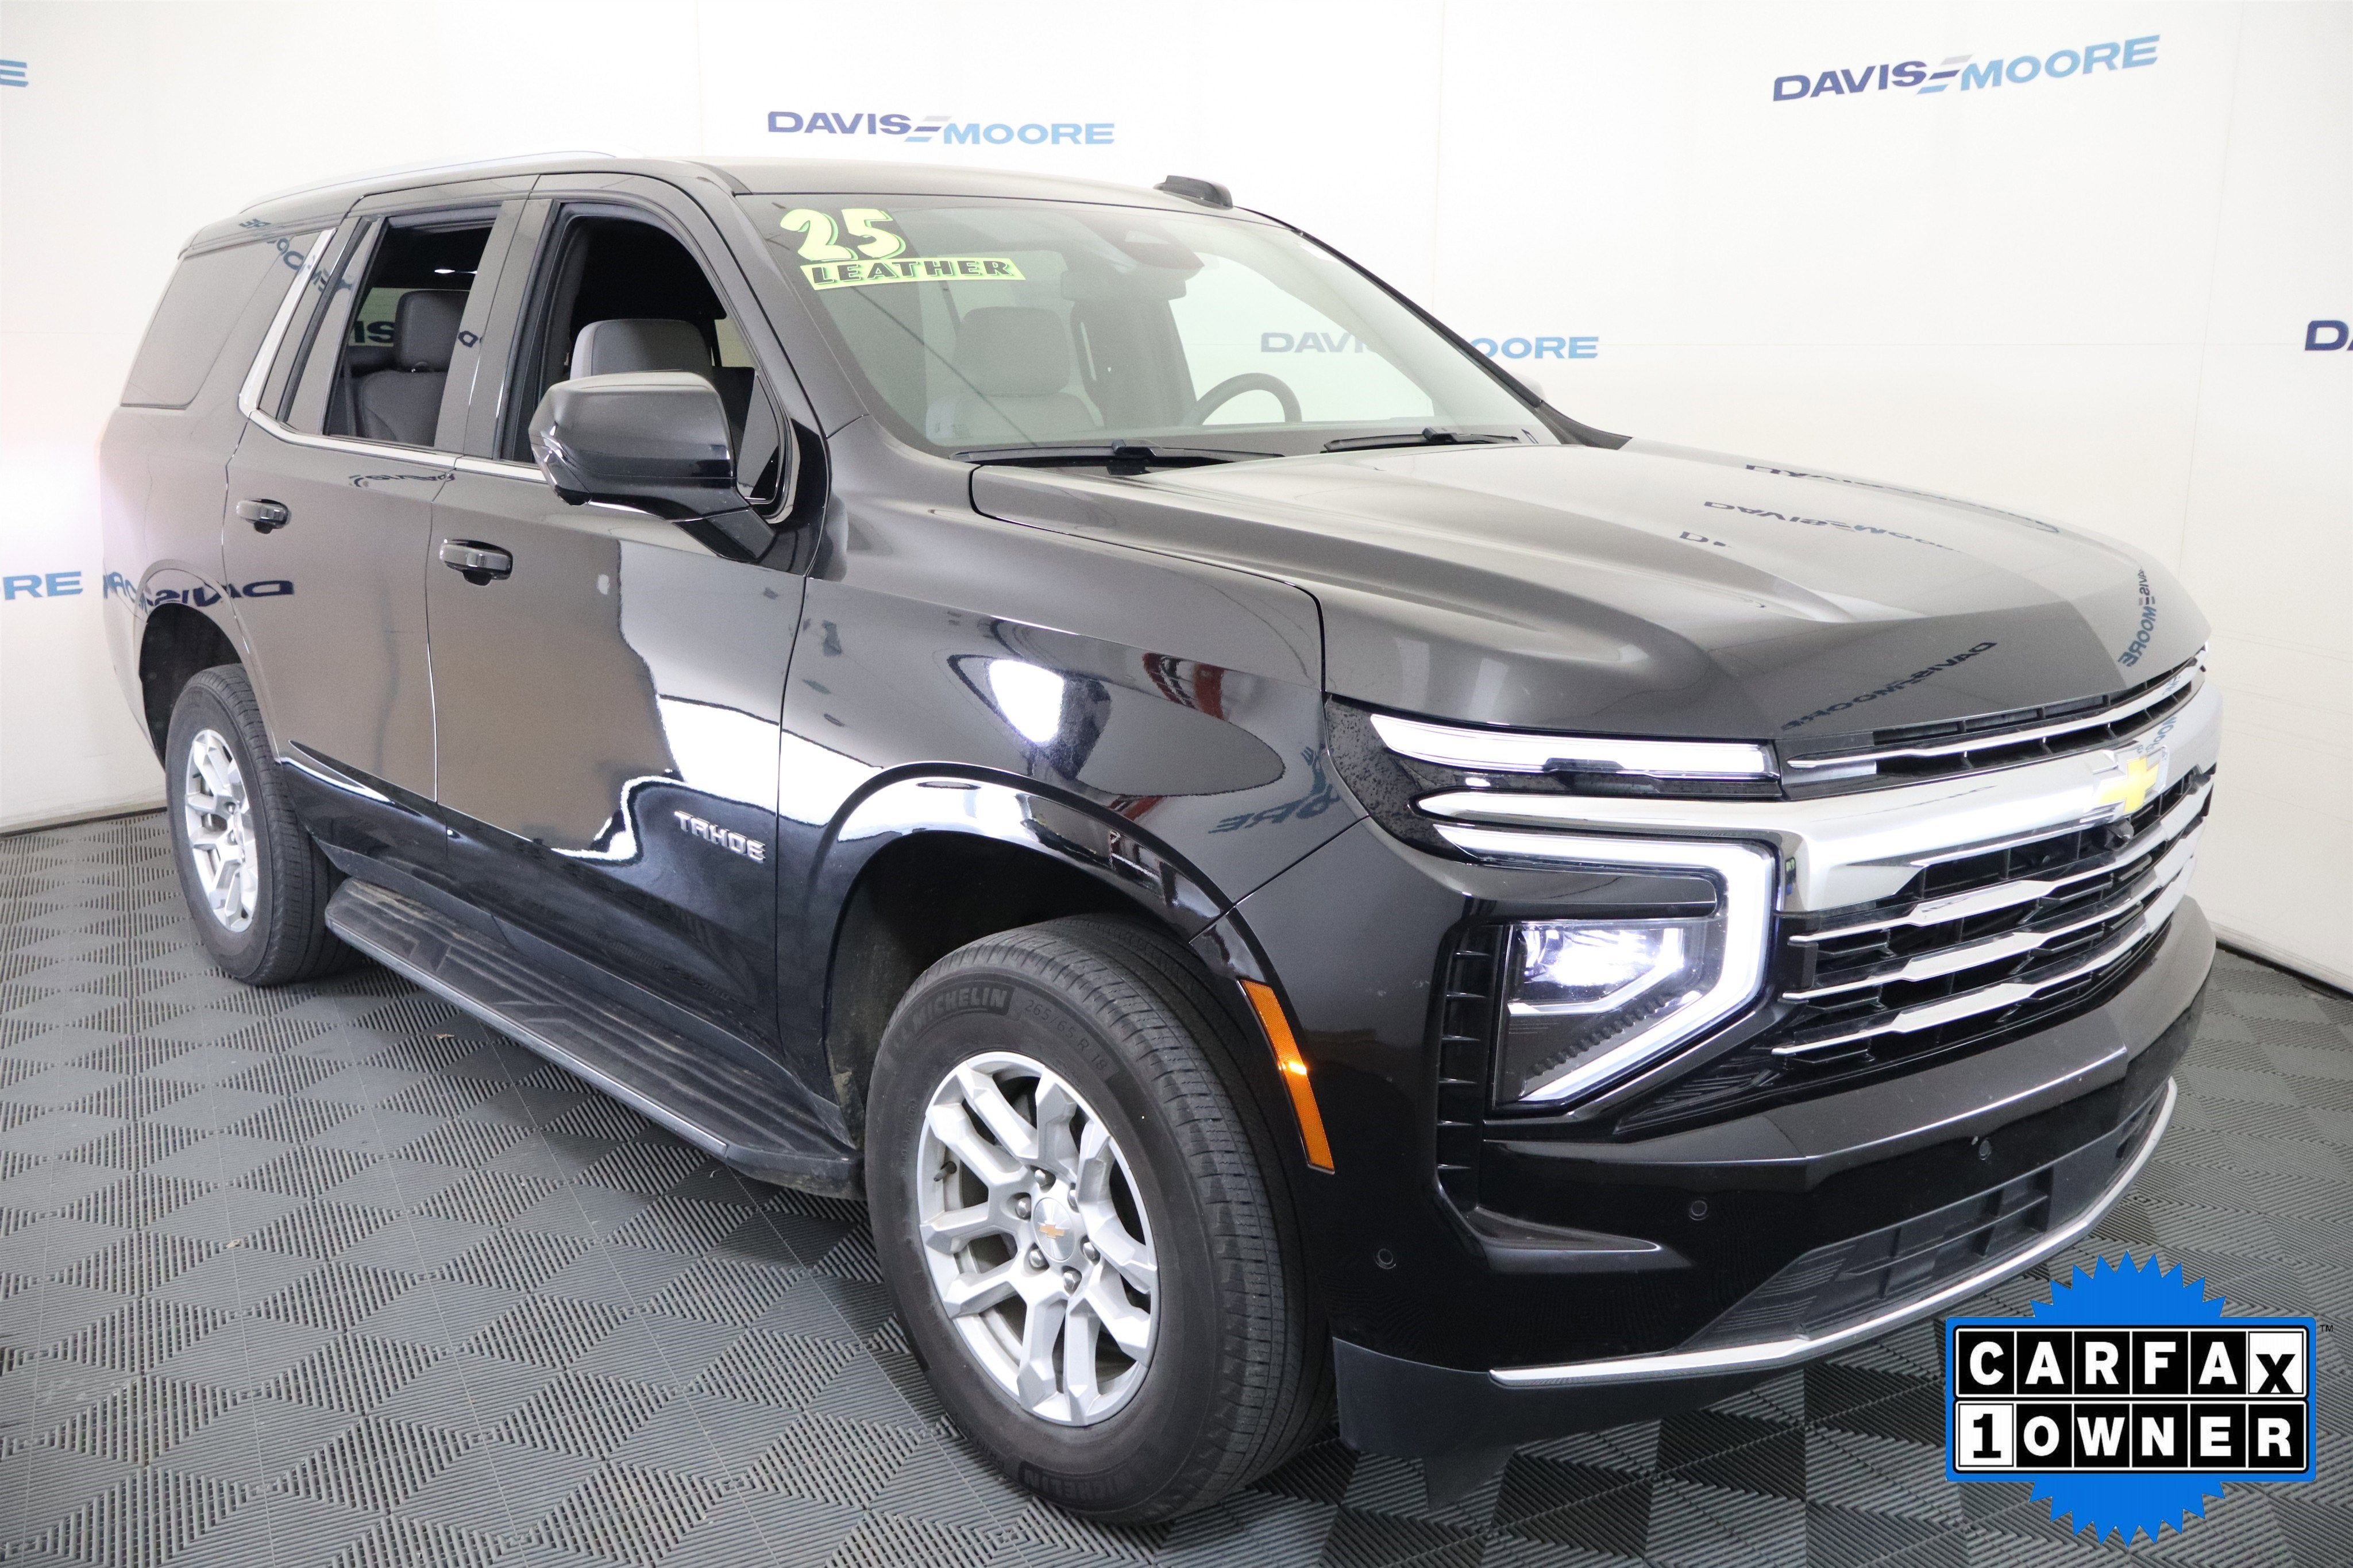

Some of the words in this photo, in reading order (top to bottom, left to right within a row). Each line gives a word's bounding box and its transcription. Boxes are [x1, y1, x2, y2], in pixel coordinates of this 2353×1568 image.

[1960, 34, 2161, 91] MOORE
[943, 123, 1115, 144] MOORE
[780, 208, 907, 261] 25
[811, 260, 1015, 285] LEATHER
[674, 810, 766, 863] TAHOE
[912, 987, 1008, 1029] MICHELIN
